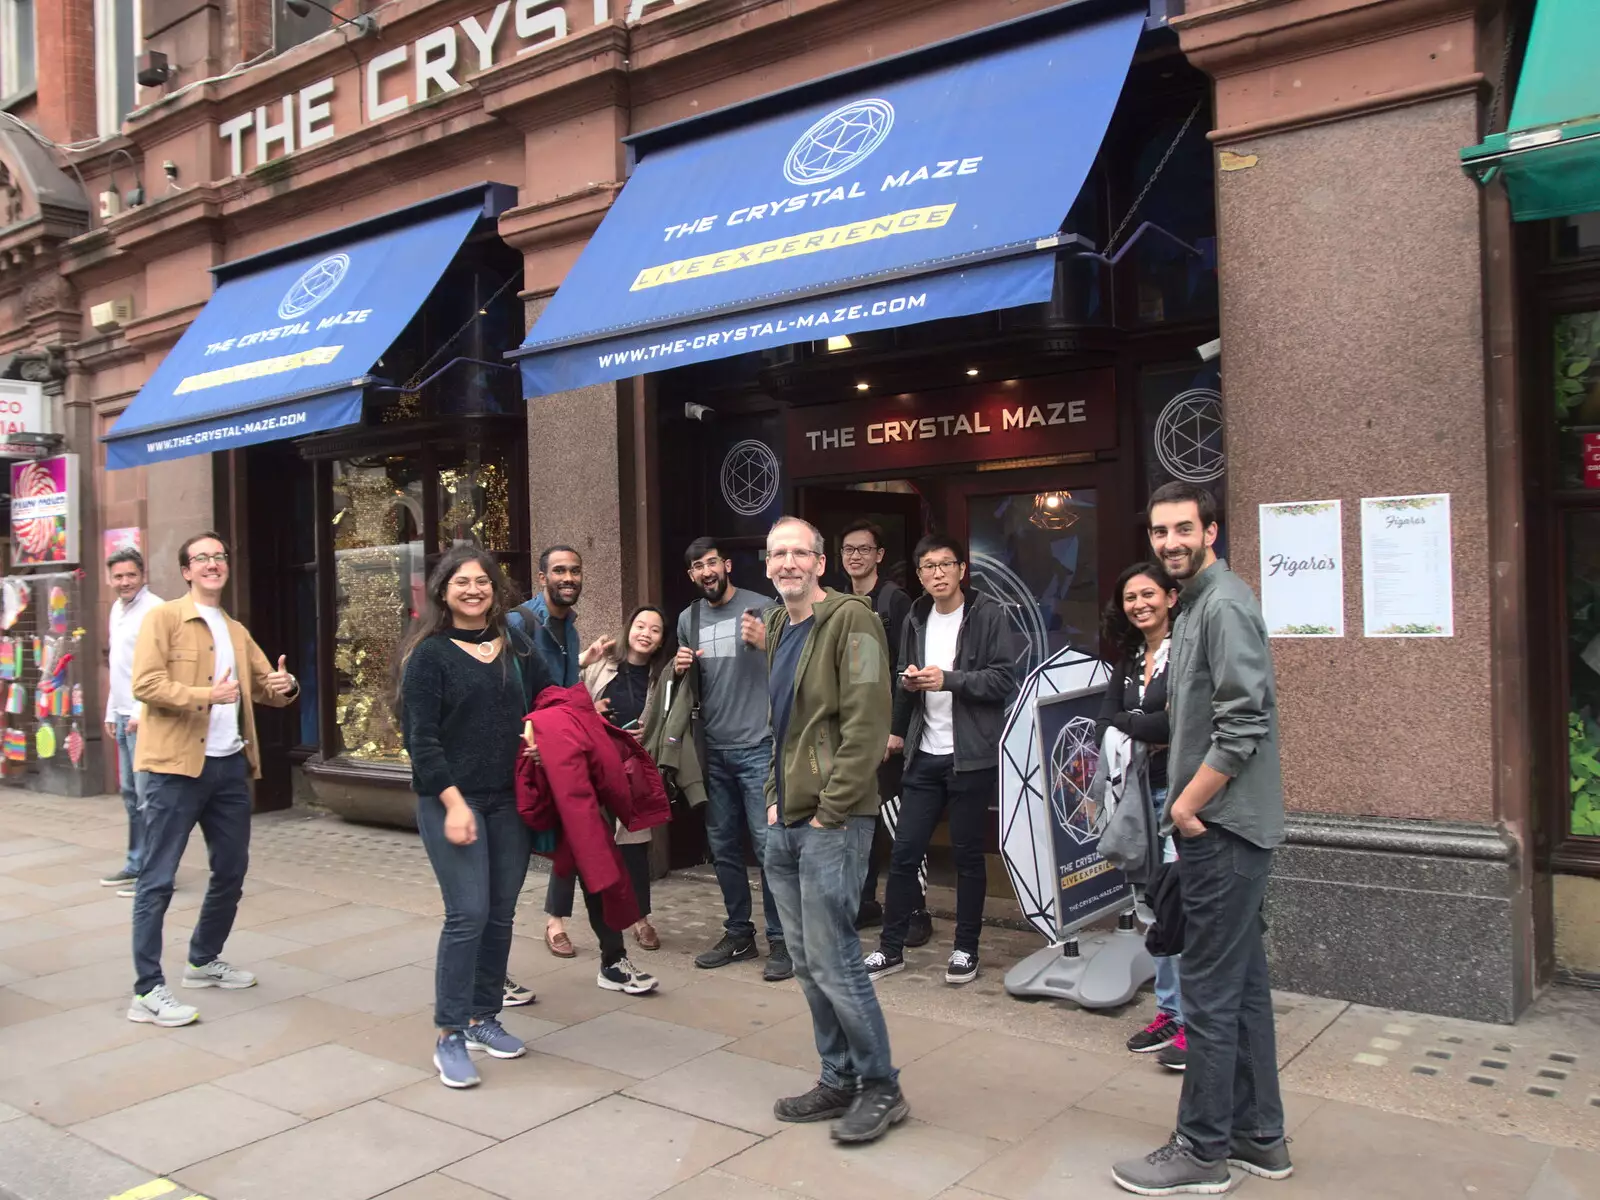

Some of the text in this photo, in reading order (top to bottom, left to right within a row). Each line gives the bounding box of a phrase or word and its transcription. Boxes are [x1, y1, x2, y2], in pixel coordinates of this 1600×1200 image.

[219, 77, 334, 175] THE
[664, 156, 983, 241] THE CRYSTAL MAZE
[637, 208, 949, 285] LIVE EXPERIENCE
[204, 308, 374, 356] THE CRYSTAL MAZE
[598, 293, 927, 368] WWW.THE-CRYSTAL-MAZE.COM
[146, 412, 307, 453] WWW.THE-CRYSTAL-MAZE.COM
[806, 400, 1087, 450] THE CRYSTAL MAZE
[1060, 851, 1104, 875] THE CRYSTA
[1062, 875, 1078, 887] LIVE
